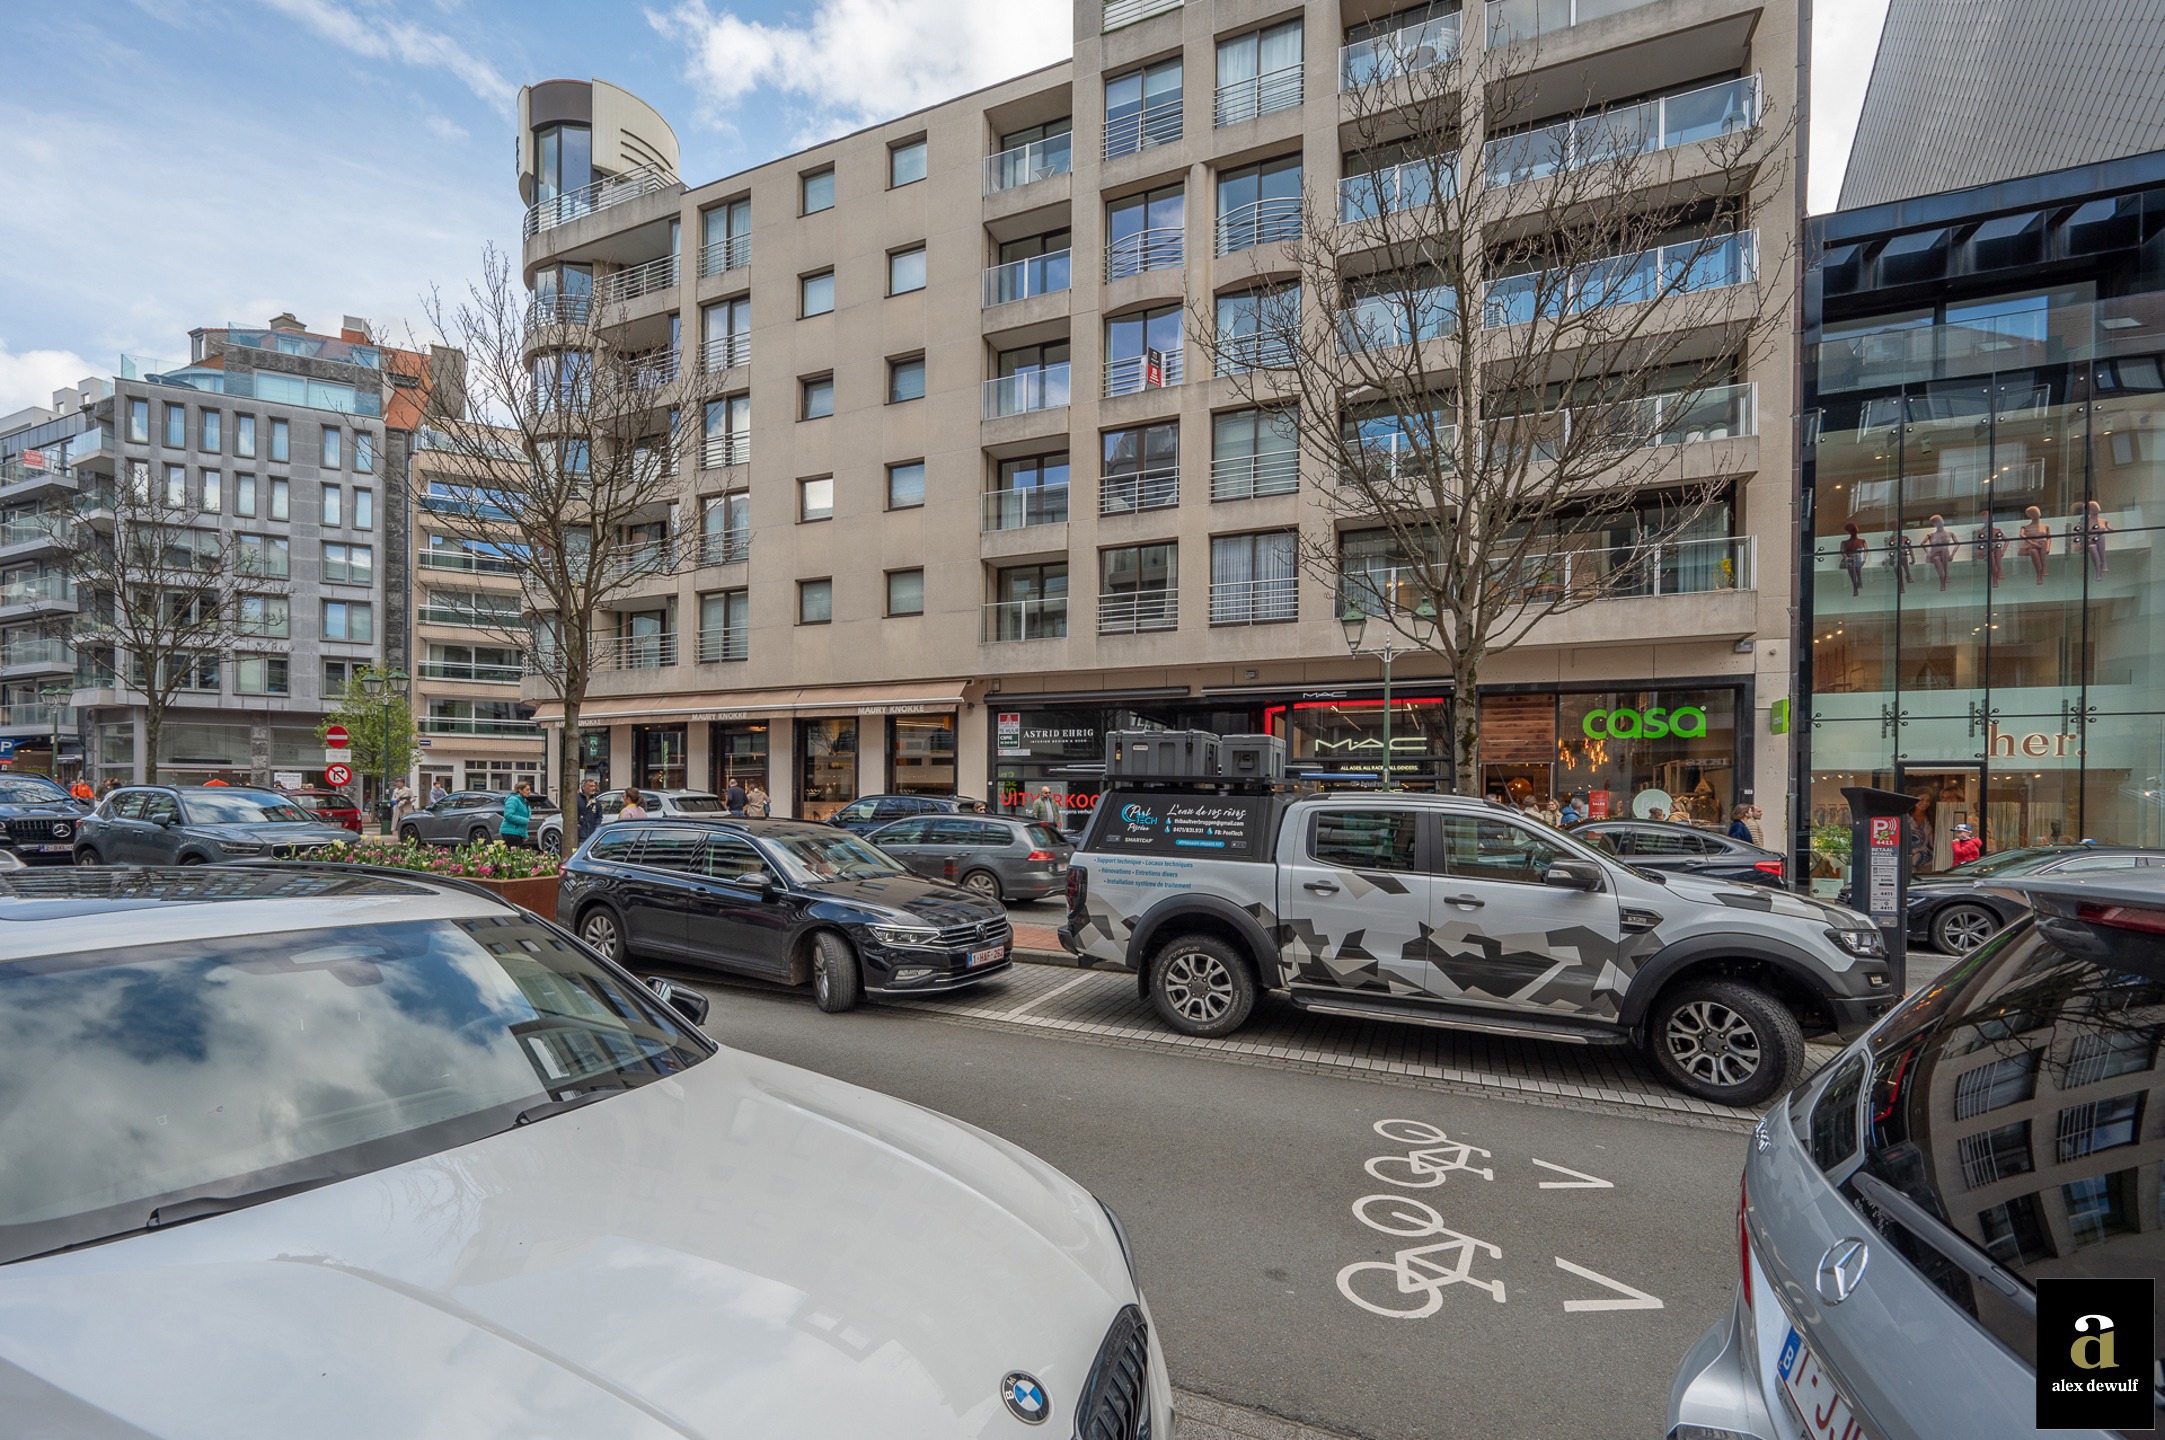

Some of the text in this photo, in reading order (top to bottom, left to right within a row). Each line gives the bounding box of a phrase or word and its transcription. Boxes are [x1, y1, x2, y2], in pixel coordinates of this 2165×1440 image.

[1303, 690, 1347, 699] MAC
[857, 704, 925, 715] MAURY KNOKKE
[692, 712, 747, 721] MAURY KNOKKE
[1583, 705, 1707, 740] casa
[1023, 728, 1094, 739] ASTRID EHRIG
[1101, 867, 1131, 875] Rénovations
[1135, 880, 1156, 888] système
